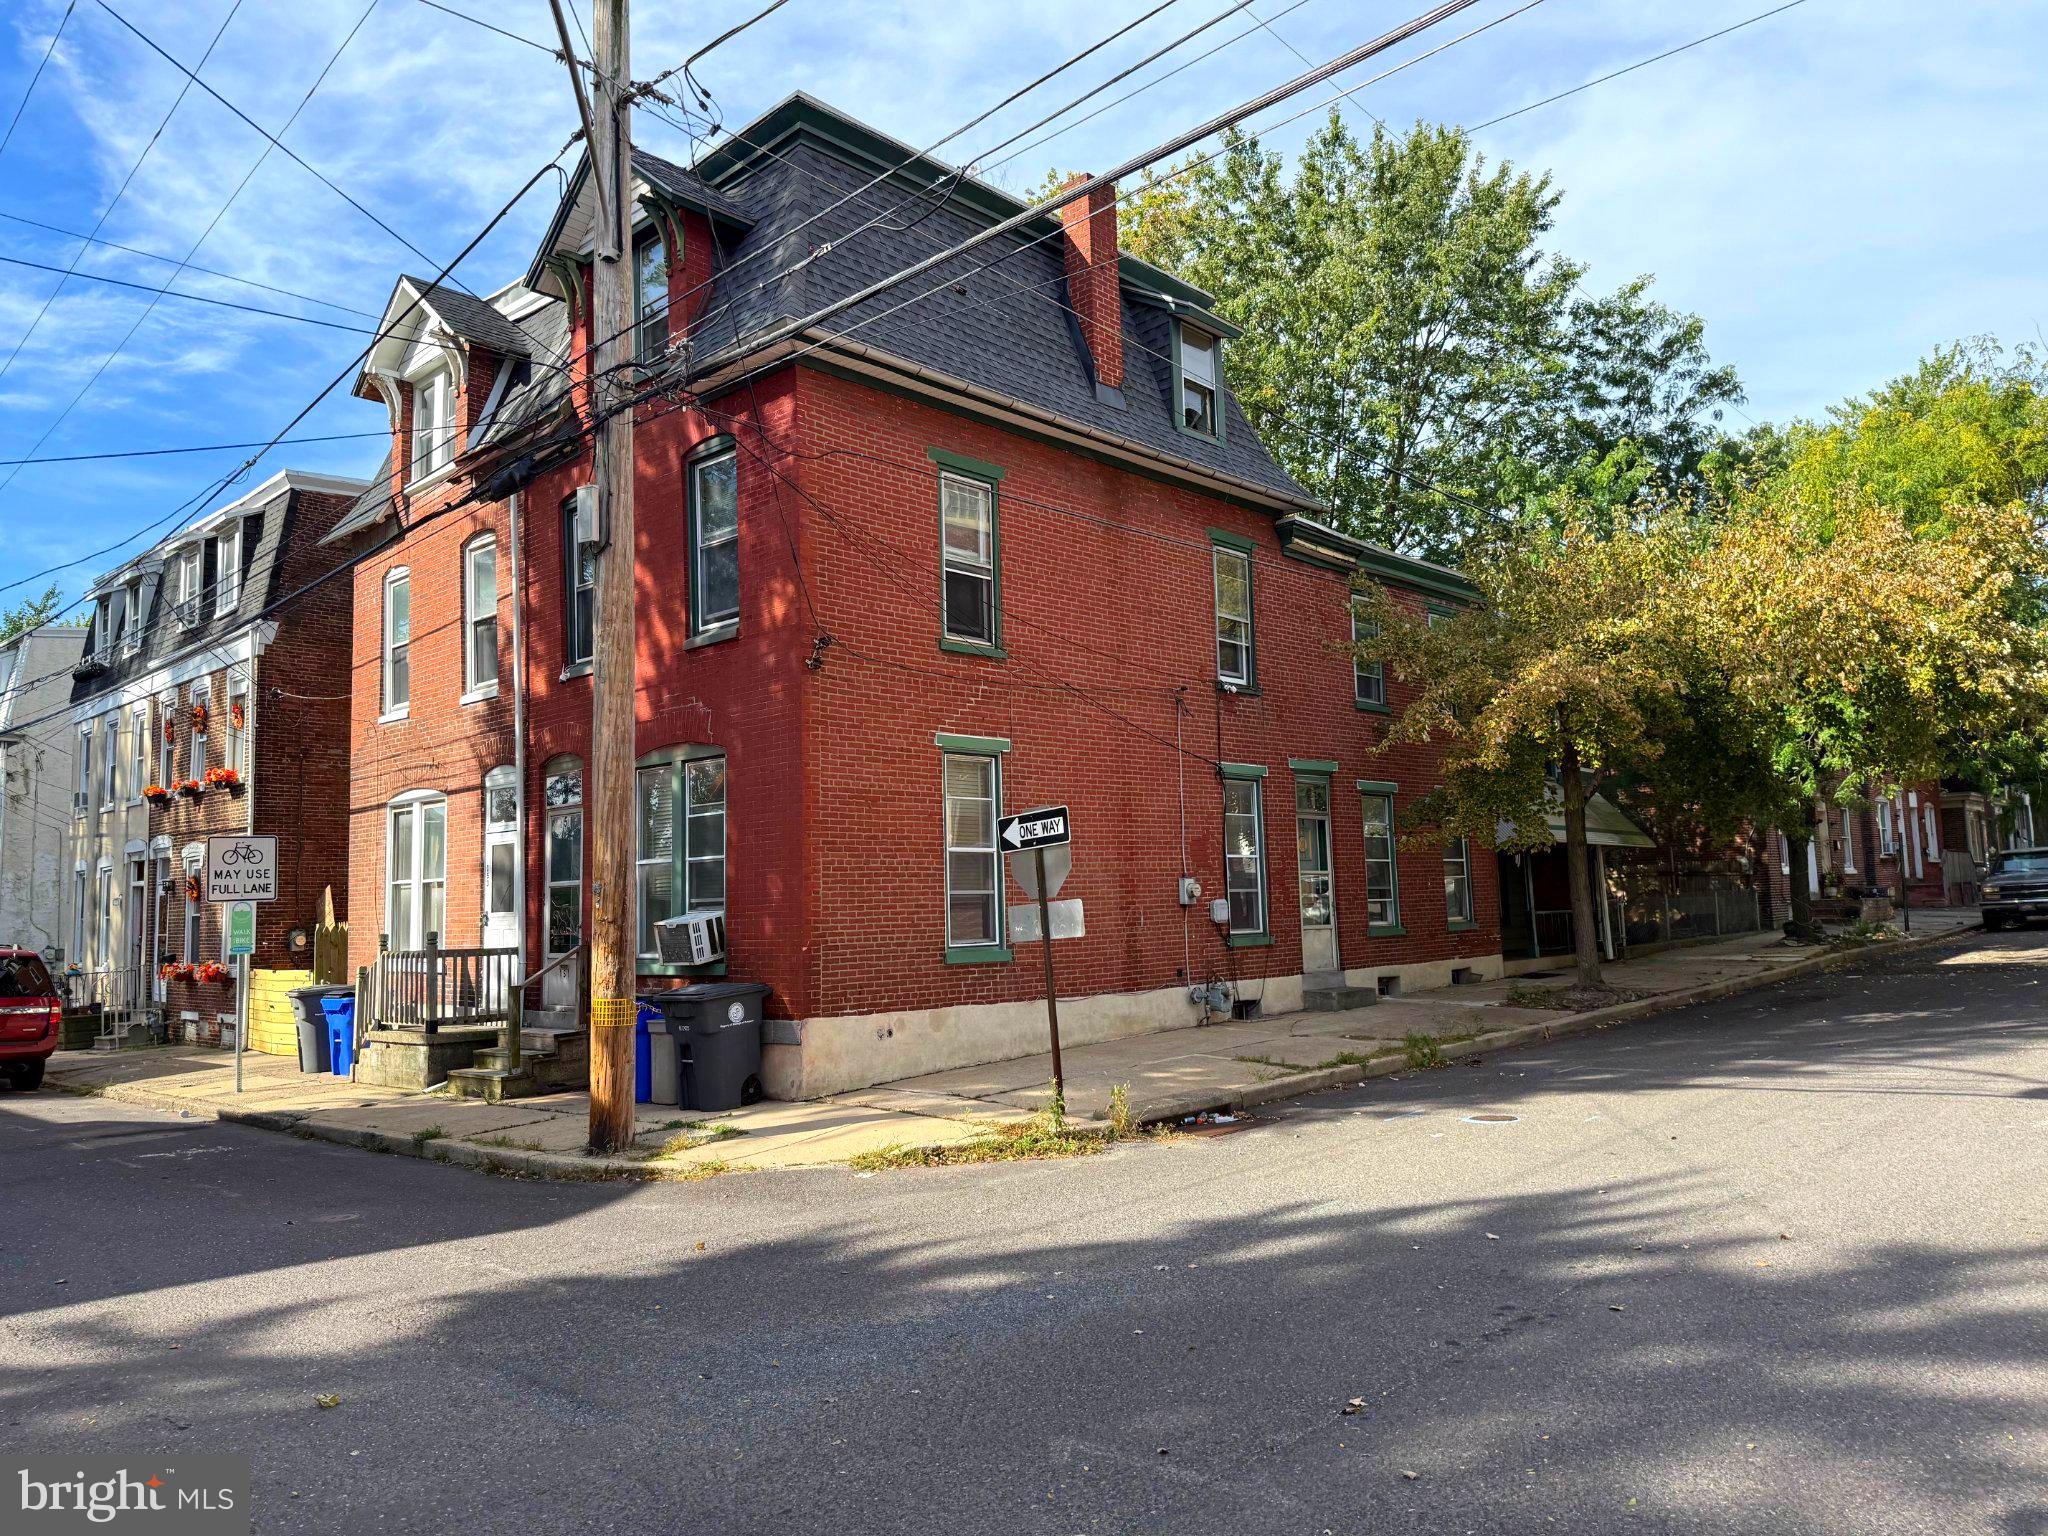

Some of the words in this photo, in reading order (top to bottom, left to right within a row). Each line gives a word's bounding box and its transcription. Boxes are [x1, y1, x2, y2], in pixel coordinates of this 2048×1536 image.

[1020, 823, 1039, 839] ONE
[1041, 818, 1061, 835] WAY
[214, 870, 241, 879] MAY
[246, 869, 270, 879] USE
[212, 884, 240, 894] FULL
[243, 883, 272, 893] LANE
